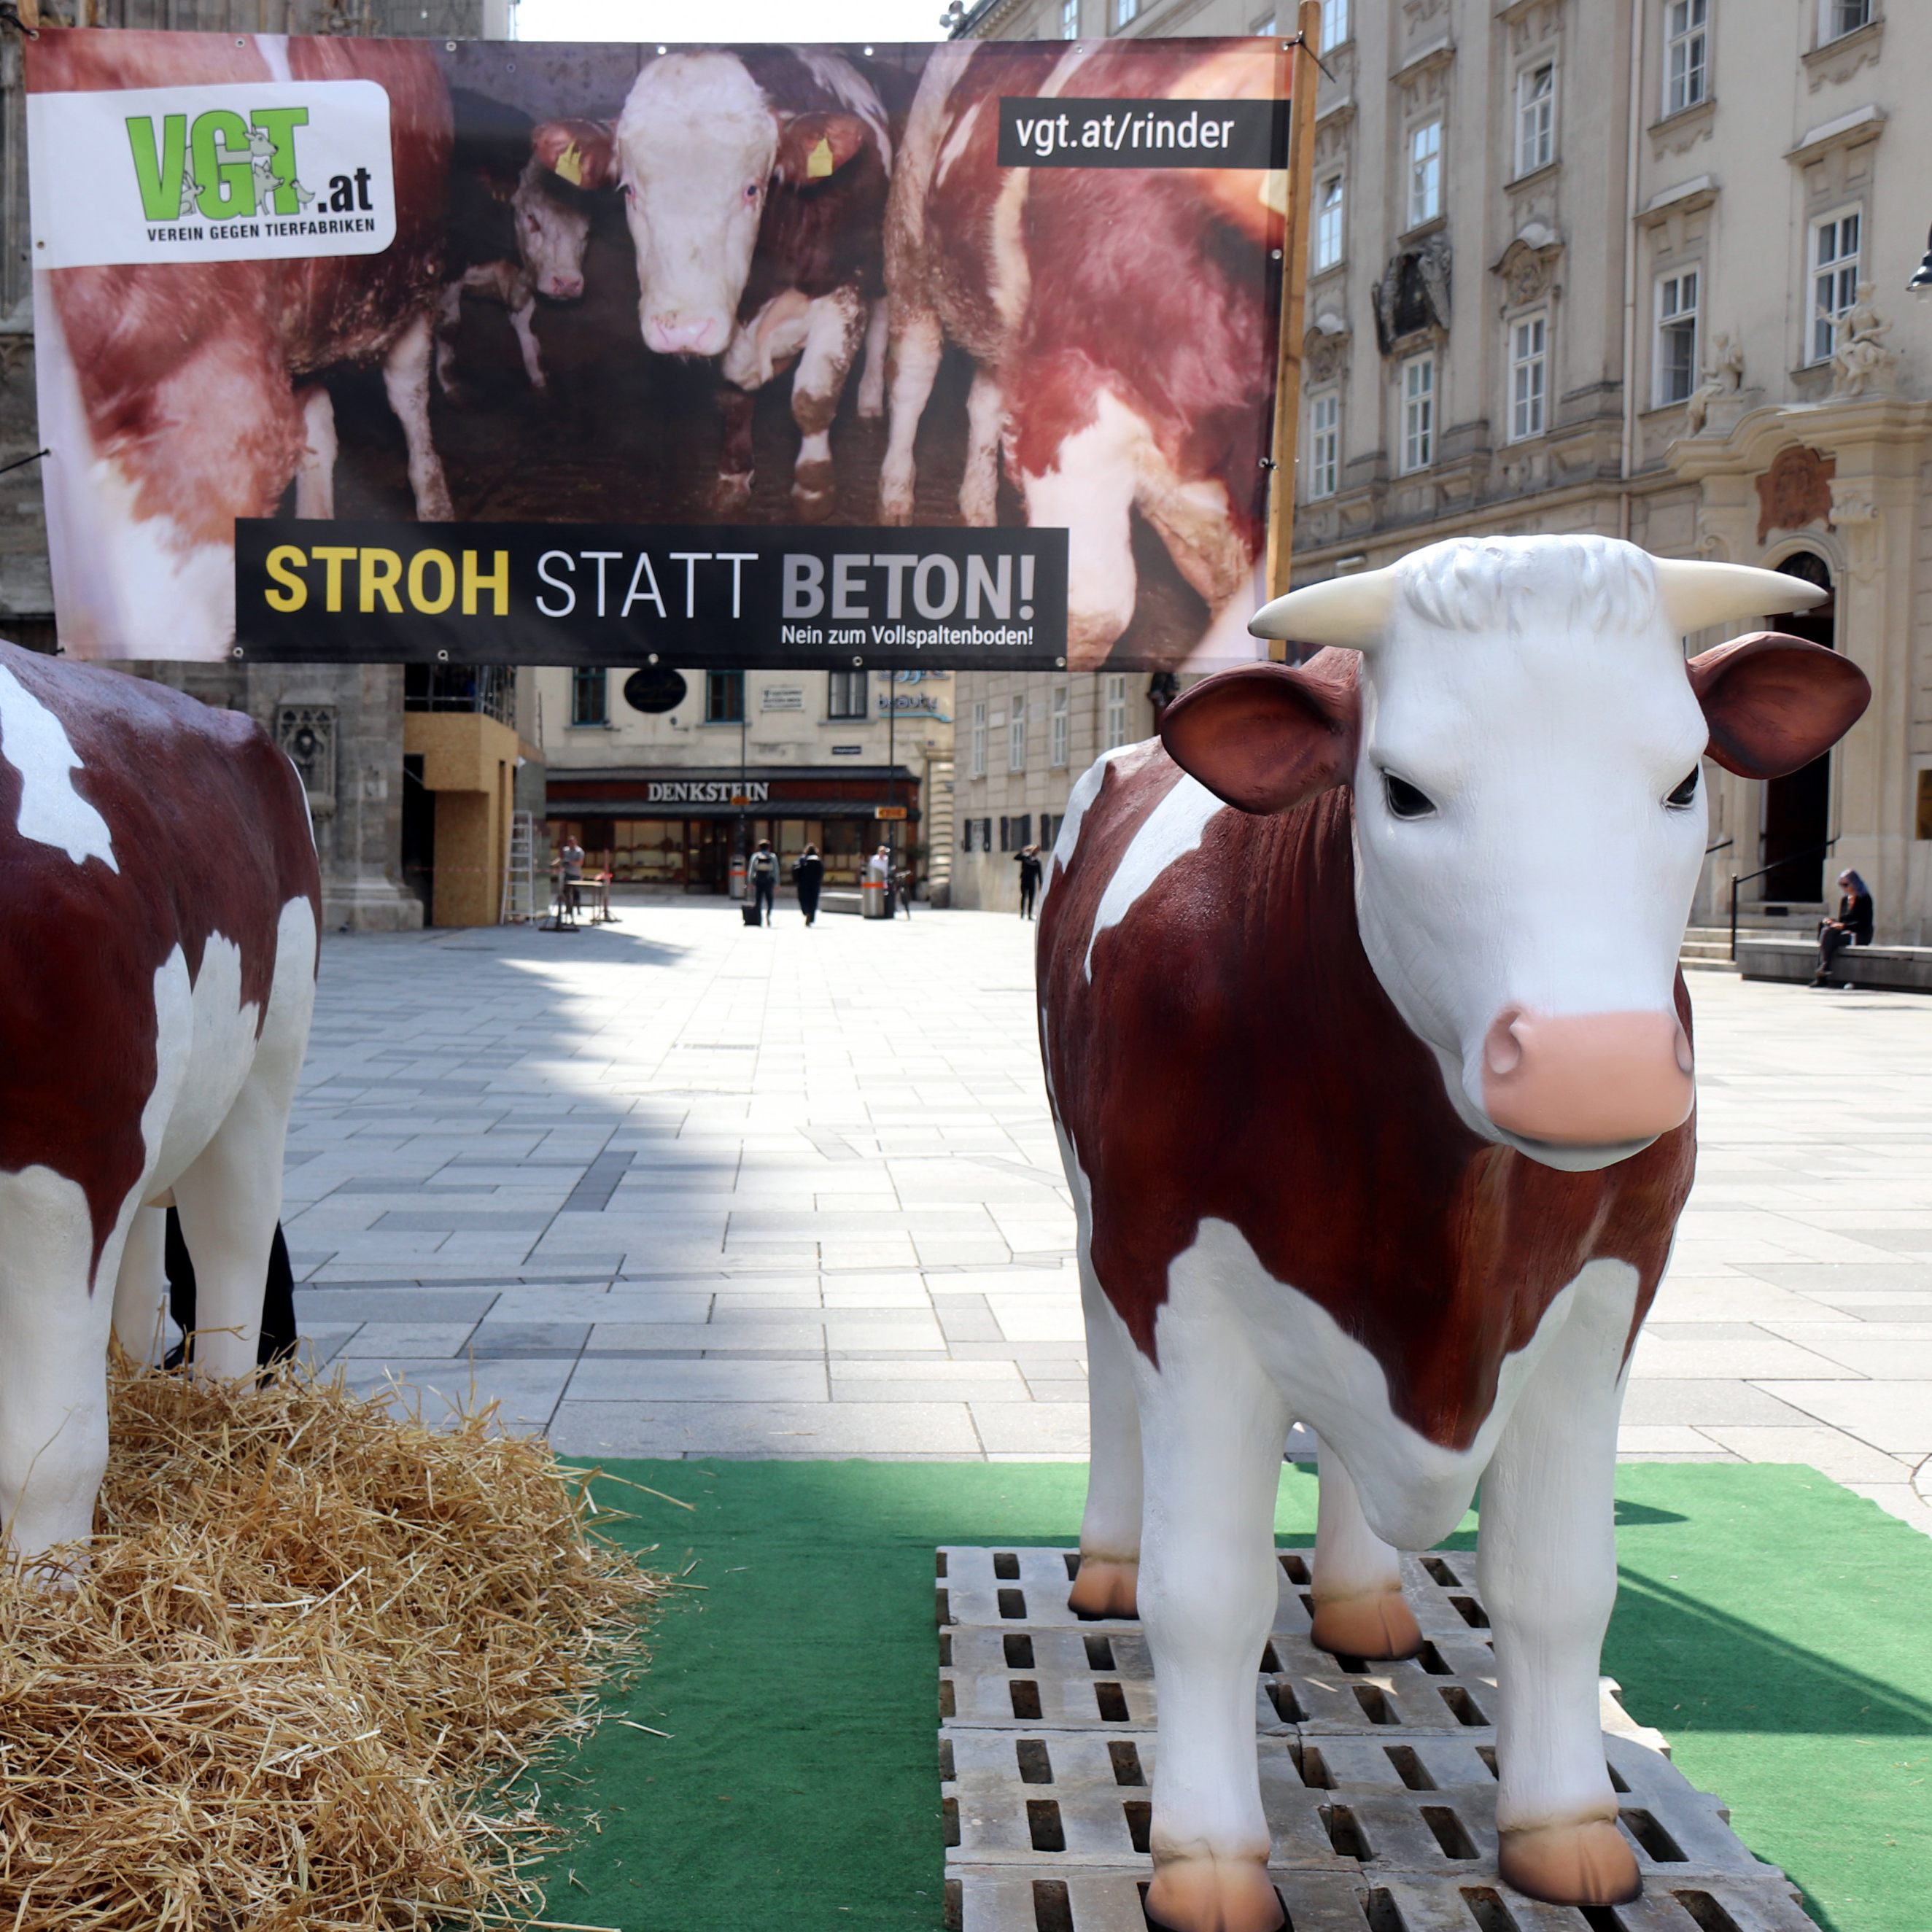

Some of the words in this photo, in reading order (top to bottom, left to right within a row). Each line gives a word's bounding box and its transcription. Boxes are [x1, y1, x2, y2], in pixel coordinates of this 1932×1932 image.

[1016, 111, 1235, 157] vgt.at/rinder
[147, 227, 203, 241] VEREIN
[210, 224, 259, 239] GEGEN
[265, 218, 375, 237] TIERFABRIKEN
[264, 544, 509, 616] STROH
[535, 550, 759, 618] STATT
[782, 553, 1036, 620] BETON!
[781, 625, 823, 644] Nein
[828, 627, 866, 644] zum
[871, 625, 1033, 648] Vollspaltenboden!
[648, 782, 769, 802] DENKSTEIN
